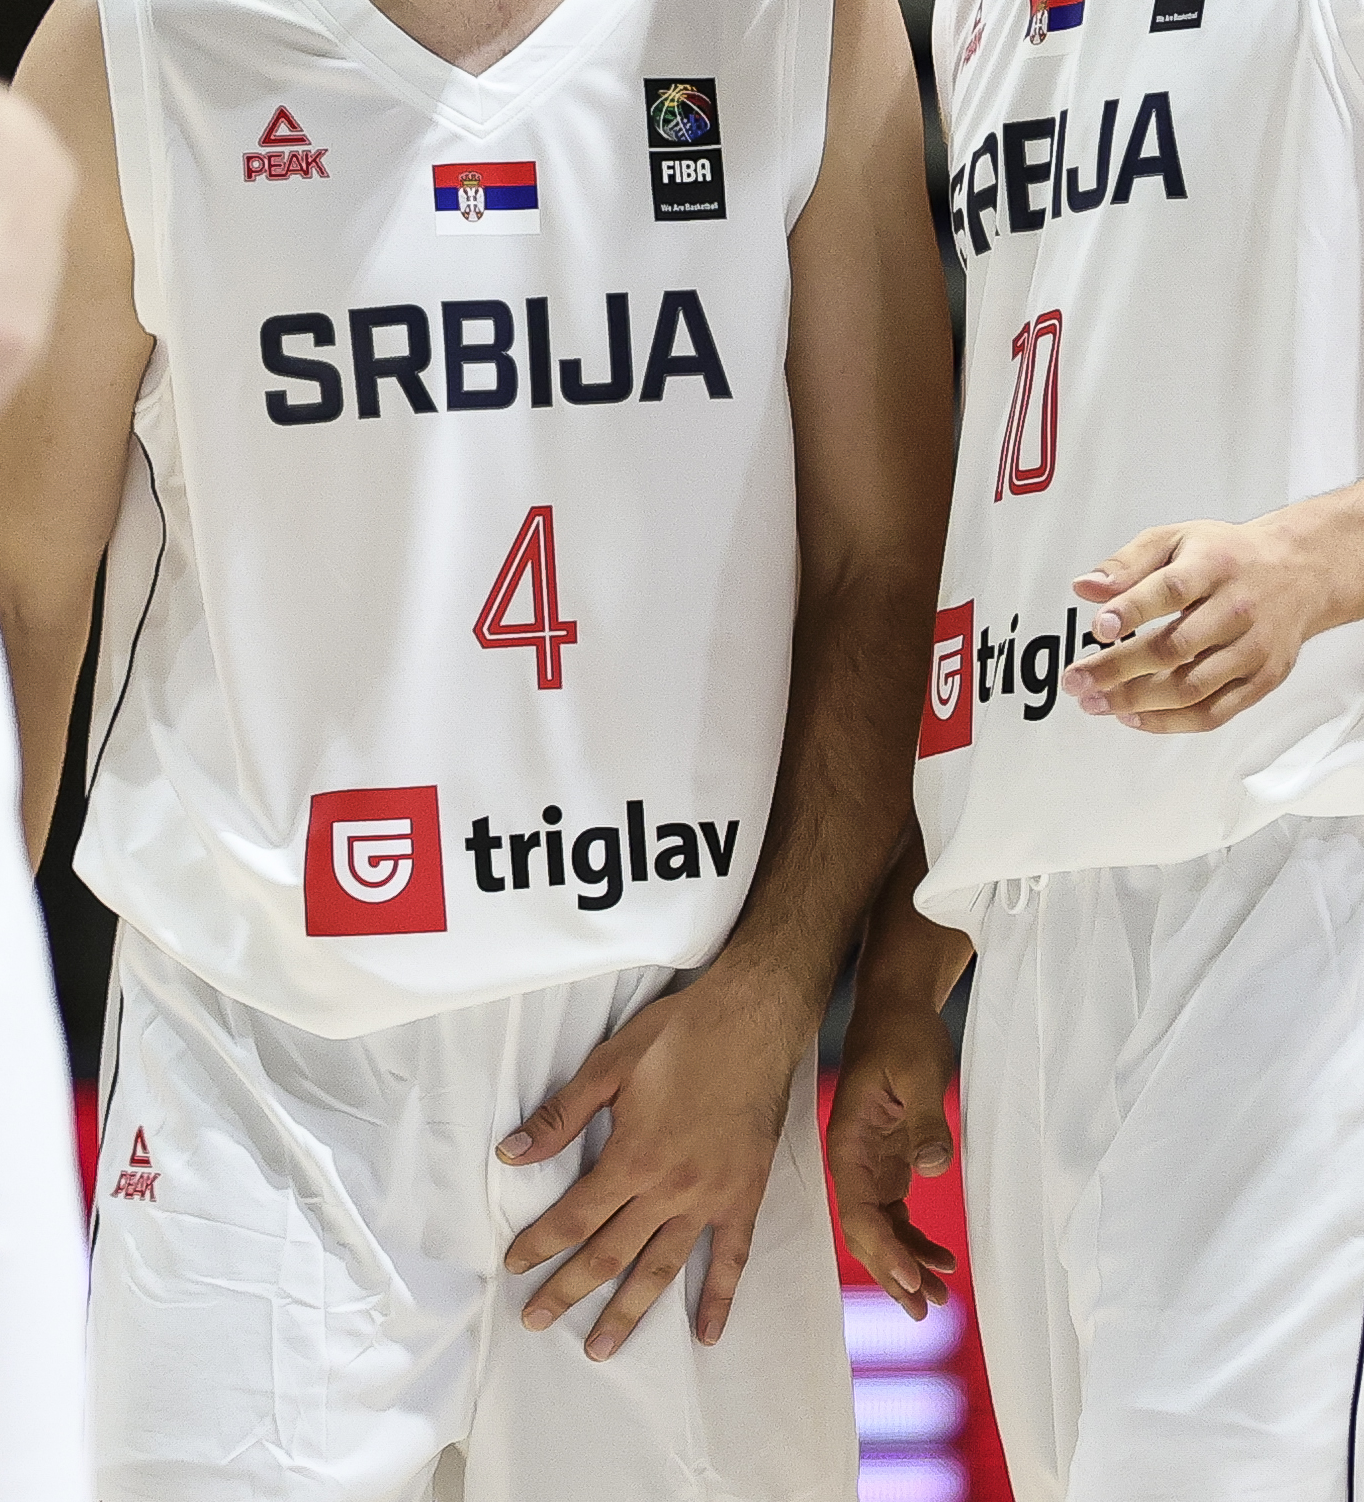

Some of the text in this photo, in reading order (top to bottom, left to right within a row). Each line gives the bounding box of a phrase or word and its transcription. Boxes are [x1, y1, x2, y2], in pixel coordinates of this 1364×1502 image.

[243, 148, 330, 182] PEAK
[661, 158, 712, 184] FIBA
[260, 289, 733, 426] SRBIJA
[993, 309, 1063, 503] 10
[472, 505, 578, 691] 4
[977, 606, 1136, 721] trigl
[465, 799, 741, 912] triglav
[109, 1169, 162, 1202] PEAK
